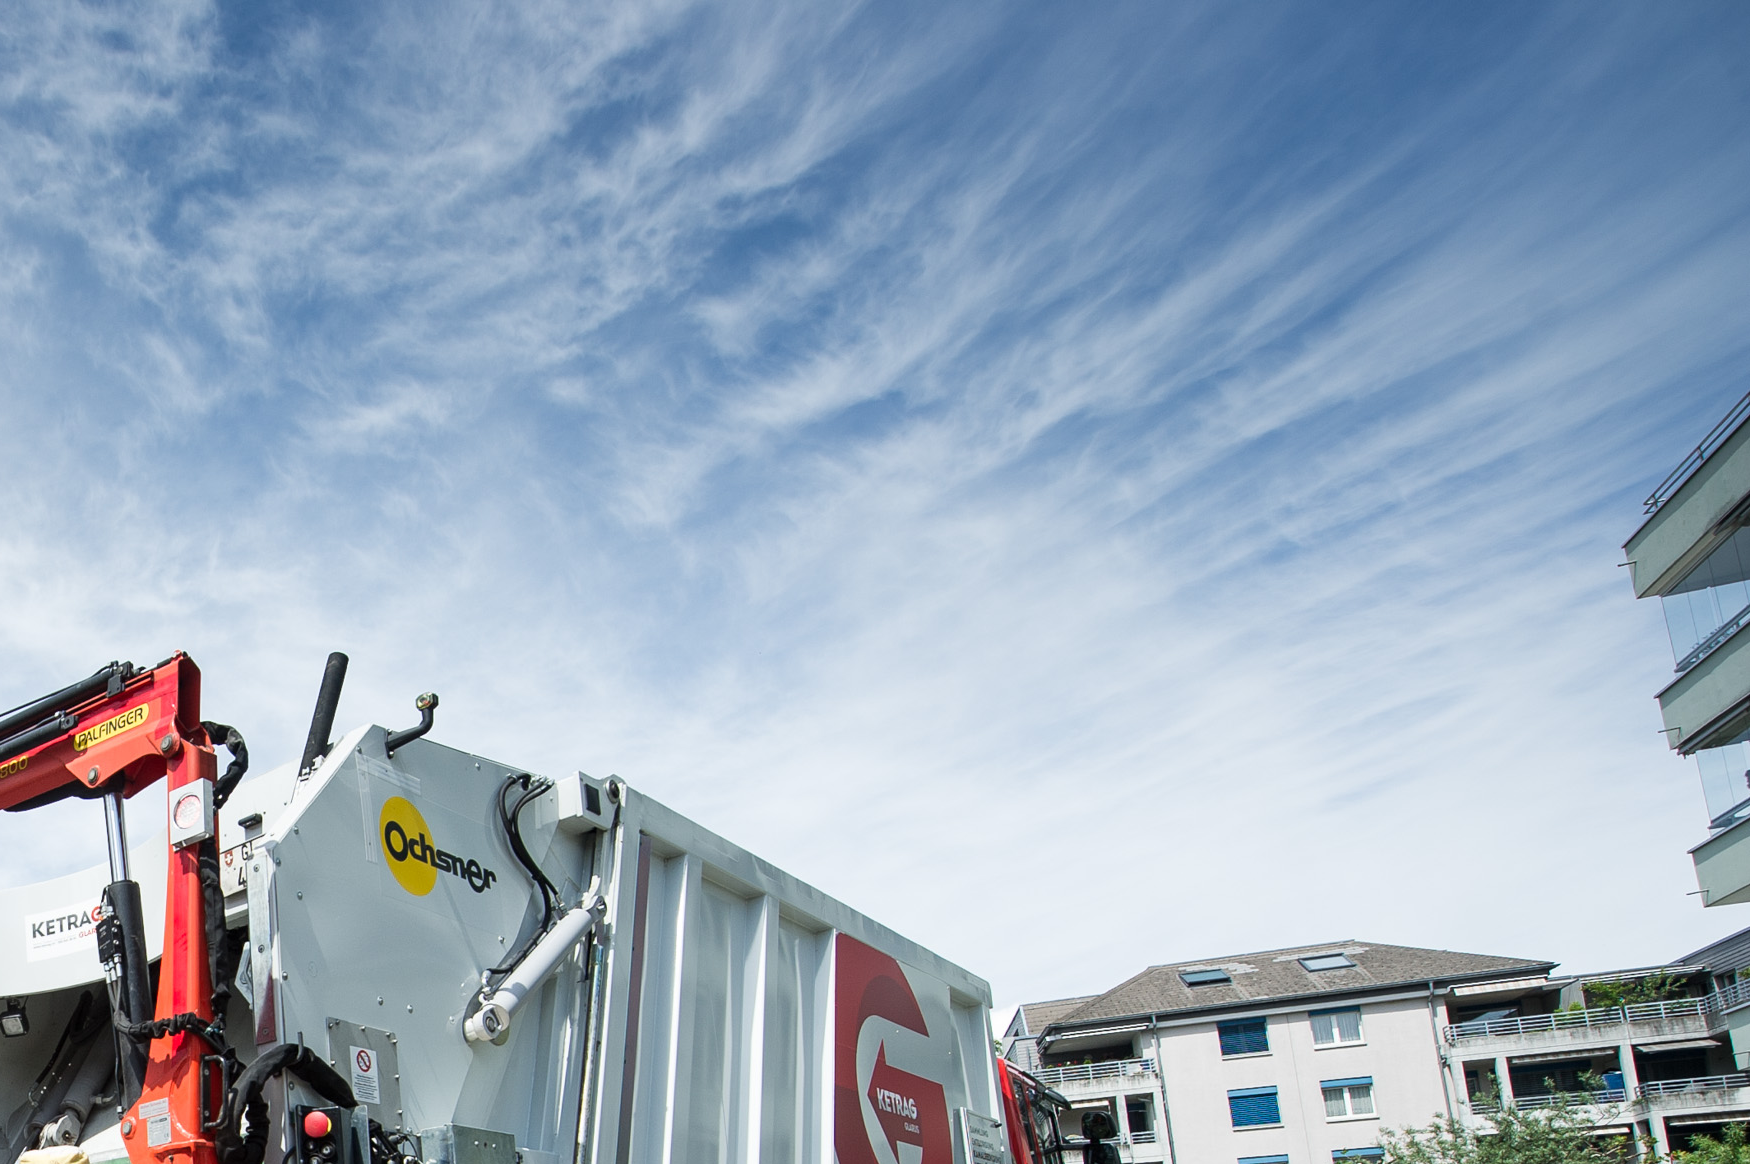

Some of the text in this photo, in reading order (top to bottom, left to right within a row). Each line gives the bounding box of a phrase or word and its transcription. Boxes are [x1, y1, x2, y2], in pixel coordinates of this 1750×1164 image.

[77, 706, 144, 749] PALFINGER
[384, 820, 498, 894] Ochsner
[876, 1087, 918, 1120] KETRAG
